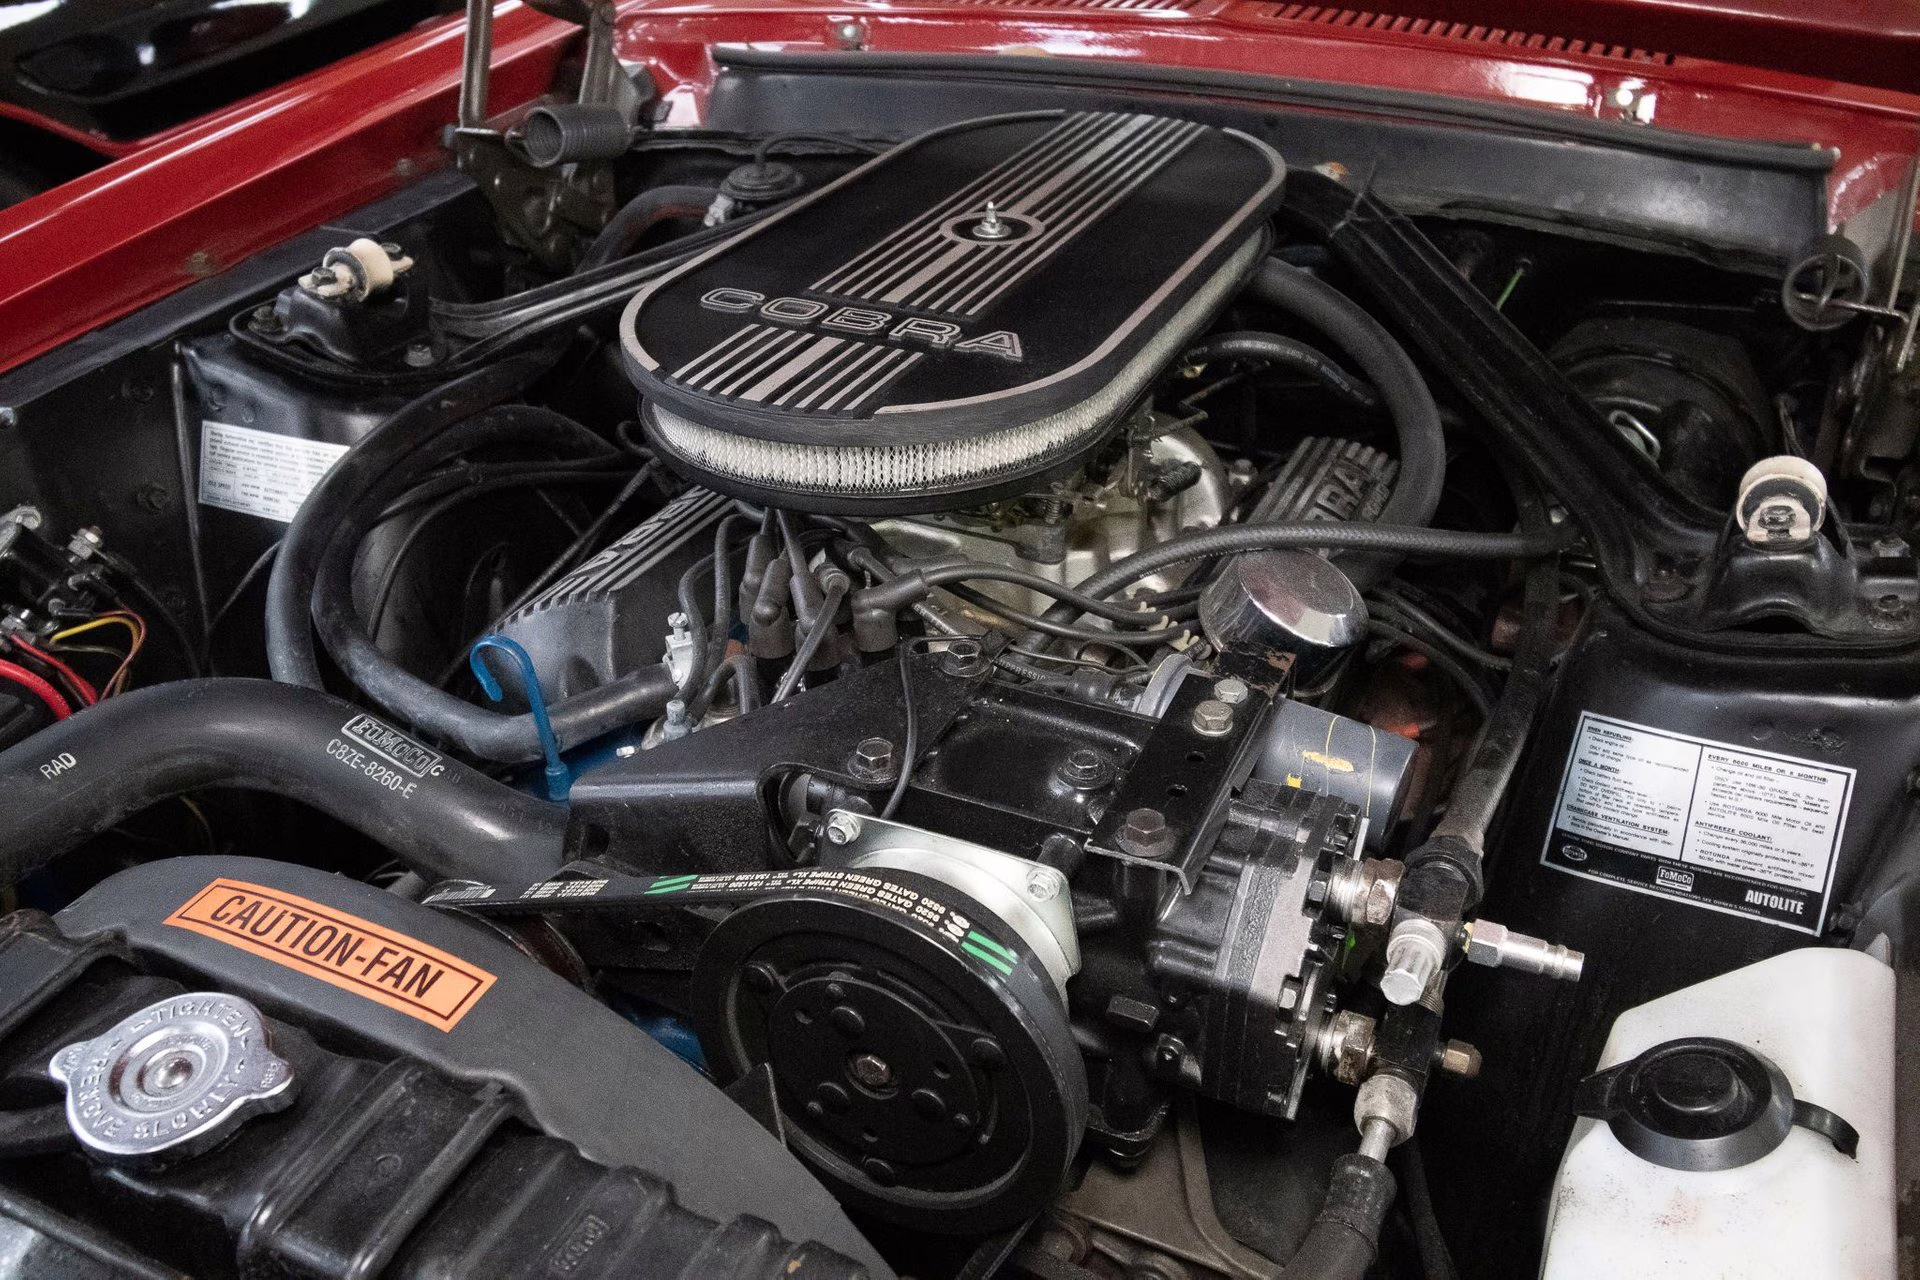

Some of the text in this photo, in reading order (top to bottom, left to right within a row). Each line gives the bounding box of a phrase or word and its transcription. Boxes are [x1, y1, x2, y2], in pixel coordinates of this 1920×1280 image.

[700, 287, 1024, 362] COBRA
[353, 717, 432, 772] FoMoCo
[40, 752, 77, 780] RAD
[326, 738, 418, 799] C8ZE-8260-E
[1707, 753, 1729, 762] EVERY
[1752, 763, 1772, 771] MILES
[803, 878, 839, 887] STRIPE
[809, 871, 845, 880] STRIPE
[845, 872, 883, 887] GREEN
[839, 880, 876, 895] GREEN
[882, 882, 919, 903] GATES
[1659, 868, 1692, 884] FoMoCo
[1744, 888, 1804, 915] AUTOLITE
[877, 889, 914, 909] GATES
[920, 897, 947, 915] 9520
[915, 905, 941, 922] 9520
[210, 895, 446, 999] CAUTION-FAN
